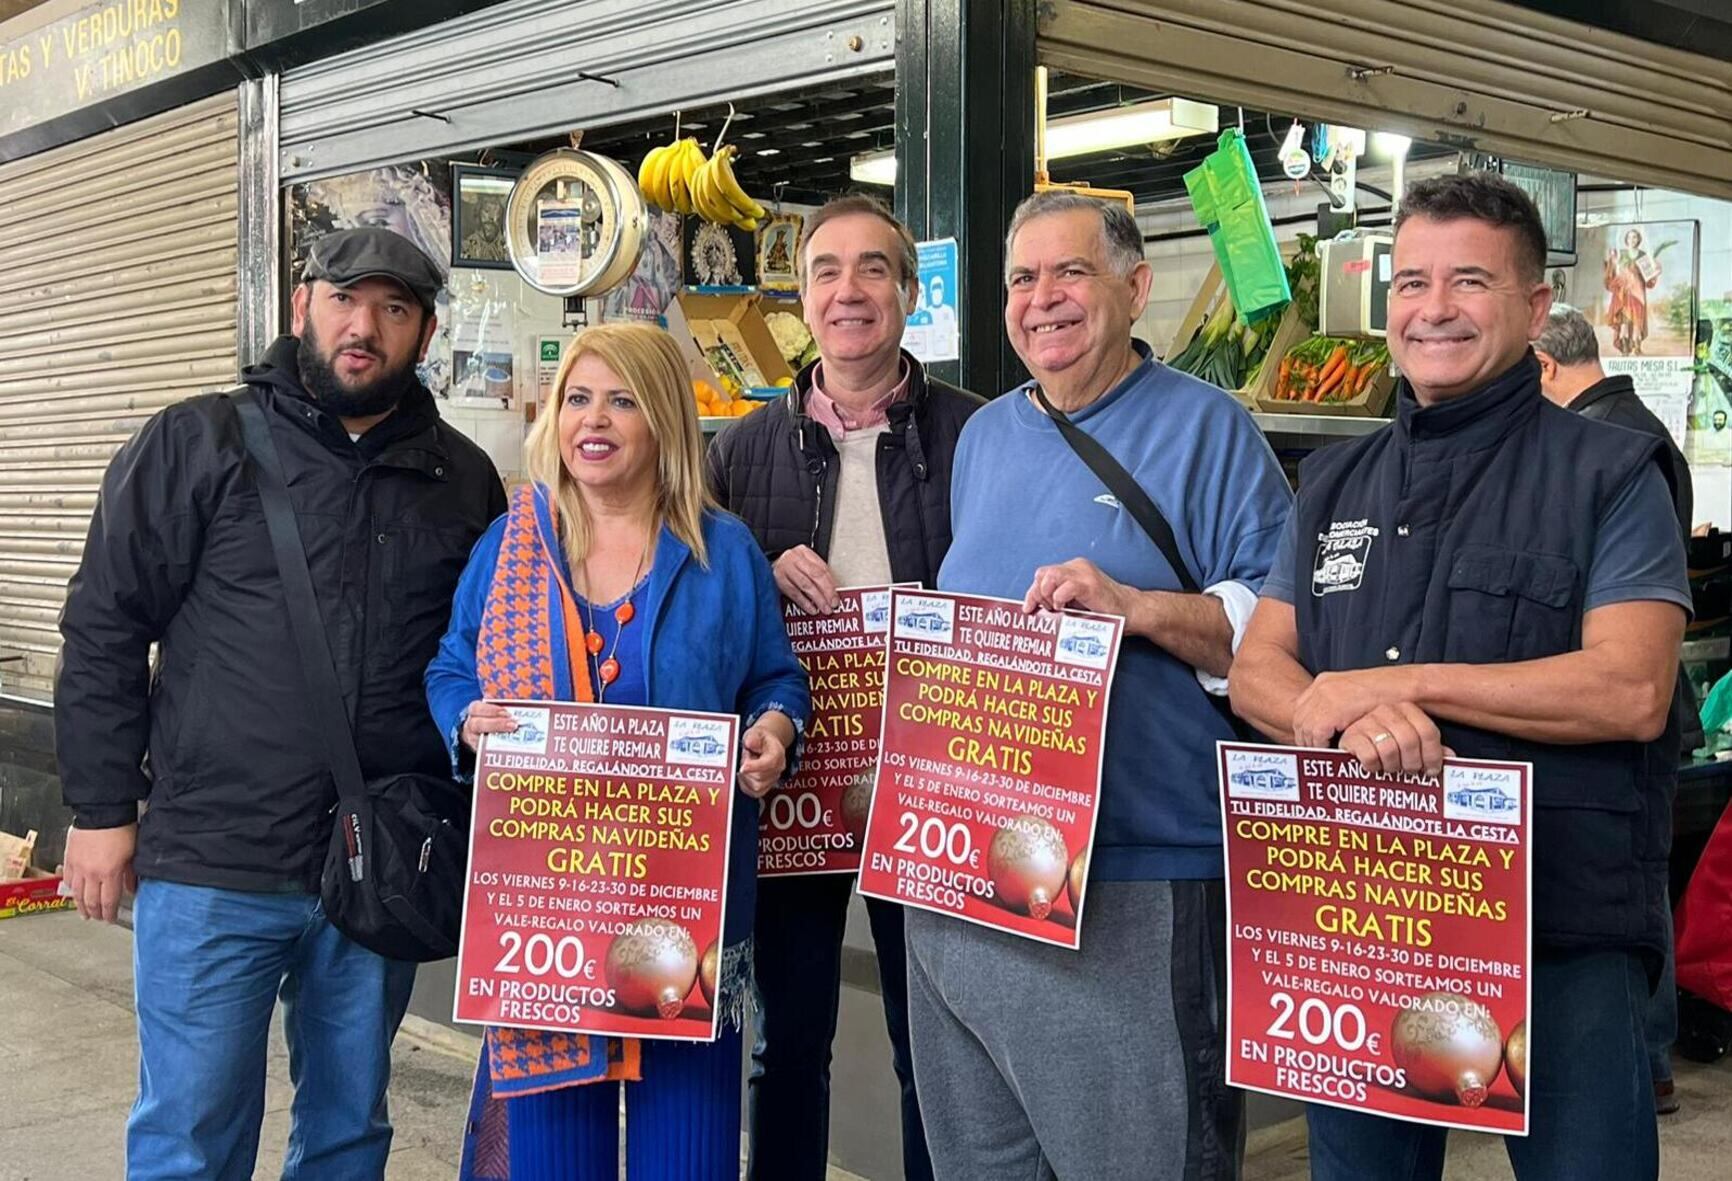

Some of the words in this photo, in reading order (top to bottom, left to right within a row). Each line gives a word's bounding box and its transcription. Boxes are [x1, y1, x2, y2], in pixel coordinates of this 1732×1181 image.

[40, 33, 52, 69] Y
[63, 0, 178, 59] VERDURAS
[101, 28, 181, 90] TINOCO
[816, 618, 859, 635] PREMIAR
[959, 605, 983, 624] ESTE
[986, 607, 1010, 627] AÑO
[1012, 611, 1025, 629] LA
[1027, 616, 1056, 635] PLAZA
[959, 627, 971, 643] TE
[974, 629, 1010, 650] QUIERE
[1013, 634, 1051, 657] PREMIAR
[817, 655, 840, 670] LA
[894, 640, 911, 653] TU
[977, 652, 1052, 675] REGALÁNDOTE
[1054, 665, 1068, 679] LA
[1070, 668, 1102, 686] CESTA
[897, 659, 971, 685] COMPRE
[977, 670, 999, 690] EN
[1004, 675, 1024, 694] LA
[1028, 679, 1080, 706] PLAZA
[1087, 690, 1098, 708] Y
[554, 714, 579, 731] ESTE
[581, 713, 607, 733] AÑO
[610, 717, 625, 734] LA
[628, 719, 664, 736] PLAZA
[919, 684, 978, 710] PODRÁ
[984, 695, 1038, 722] HACER
[1042, 709, 1073, 728] SUS
[554, 736, 566, 753] TE
[569, 738, 609, 756] QUIERE
[612, 741, 661, 759] PREMIAR
[851, 739, 866, 752] DE
[899, 703, 983, 734] COMPRAS
[988, 718, 1086, 755] NAVIDEÑAS
[485, 753, 501, 767] TU
[574, 760, 663, 778] REGALÁNDOTE
[667, 767, 683, 779] LA
[687, 769, 725, 783] CESTA
[948, 736, 1033, 776] GRATIS
[1303, 759, 1335, 778] ESTE
[1337, 760, 1371, 779] AÑO
[486, 772, 568, 796] COMPRE
[574, 778, 599, 797] EN
[606, 781, 631, 799] LA
[638, 782, 700, 804] PLAZA
[708, 788, 720, 806] Y
[884, 751, 905, 766] LOS
[909, 757, 952, 777] VIERNES
[955, 767, 1014, 790] 9-16-23-30
[1016, 779, 1030, 793] DE
[1032, 783, 1092, 807] DICIEMBRE
[893, 773, 901, 785] Y
[903, 775, 914, 788] EL
[918, 778, 925, 790] 5
[928, 780, 941, 793] DE
[943, 783, 980, 802] ENERO
[983, 791, 1054, 819] SORTEAMOS
[1056, 808, 1076, 824] UN
[1307, 782, 1323, 800] TE
[1327, 784, 1376, 806] QUIERE
[1379, 788, 1437, 814] PREMIAR
[510, 796, 577, 818] PODRÁ
[585, 802, 650, 824] HACER
[657, 807, 692, 827] SUS
[898, 793, 972, 820] VALE-REGALO
[976, 810, 1041, 838] VALORADO
[1044, 827, 1064, 843] EN:
[1230, 800, 1251, 814] TU
[1336, 808, 1443, 835] REGALÁNDOTE
[1447, 823, 1467, 837] LA
[1470, 827, 1519, 844] CESTA
[489, 818, 585, 842] COMPRAS
[592, 825, 710, 852] NAVIDEÑAS
[893, 811, 981, 870] 200€
[1237, 820, 1331, 847] COMPRE
[1338, 830, 1368, 850] EN
[1376, 835, 1405, 856] LA
[1414, 839, 1491, 869] PLAZA
[1499, 848, 1514, 870] Y
[547, 847, 648, 878] GRATIS
[871, 852, 893, 872] EN
[897, 858, 995, 898] PRODUCTOS
[1267, 846, 1346, 873] PODRÁ
[1354, 856, 1432, 885] HACER
[1440, 867, 1483, 892] SUS
[18, 895, 66, 912] Corral
[474, 872, 498, 885] LOS
[501, 874, 555, 890] VIERNES
[558, 879, 627, 896] 9-16-23-30
[630, 883, 646, 897] DE
[650, 885, 718, 902] DICIEMBRE
[486, 893, 496, 905] Y
[499, 894, 512, 906] EL
[517, 895, 524, 907] 5
[529, 897, 544, 908] DE
[549, 898, 591, 912] ENERO
[596, 902, 676, 918] SORTEAMOS
[681, 906, 701, 920] UN
[897, 878, 965, 910] FRESCOS
[1247, 870, 1357, 901] COMPRAS
[1365, 883, 1508, 921] NAVIDEÑAS
[494, 913, 584, 931] VALE-REGALO
[589, 920, 665, 937] VALORADO
[668, 925, 691, 939] EN:
[1315, 905, 1433, 947] GRATIS
[494, 931, 596, 980] 200€
[1235, 924, 1263, 941] LOS
[1267, 929, 1326, 951] VIERNES
[1330, 938, 1409, 964] 9-16-23-30
[1413, 950, 1434, 968] DE
[1438, 954, 1522, 979] DICIEMBRE
[469, 978, 494, 996] EN
[500, 980, 615, 1007] PRODUCTOS
[1251, 948, 1262, 962] Y
[1265, 950, 1281, 965] EL
[1286, 953, 1294, 967] 5
[1298, 955, 1317, 970] DE
[1321, 958, 1370, 980] ENERO
[1374, 967, 1472, 996] SORTEAMOS
[1476, 982, 1503, 999] UN
[500, 1000, 580, 1023] FRESCOS
[1262, 971, 1364, 1000] VALE-REGALO
[1368, 988, 1459, 1016] VALORADO
[1463, 1003, 1490, 1018] EN:
[1265, 992, 1382, 1056] 200€
[1240, 1040, 1267, 1063] EN
[1274, 1045, 1407, 1088] PRODUCTOS
[1276, 1068, 1367, 1102] FRESCOS
